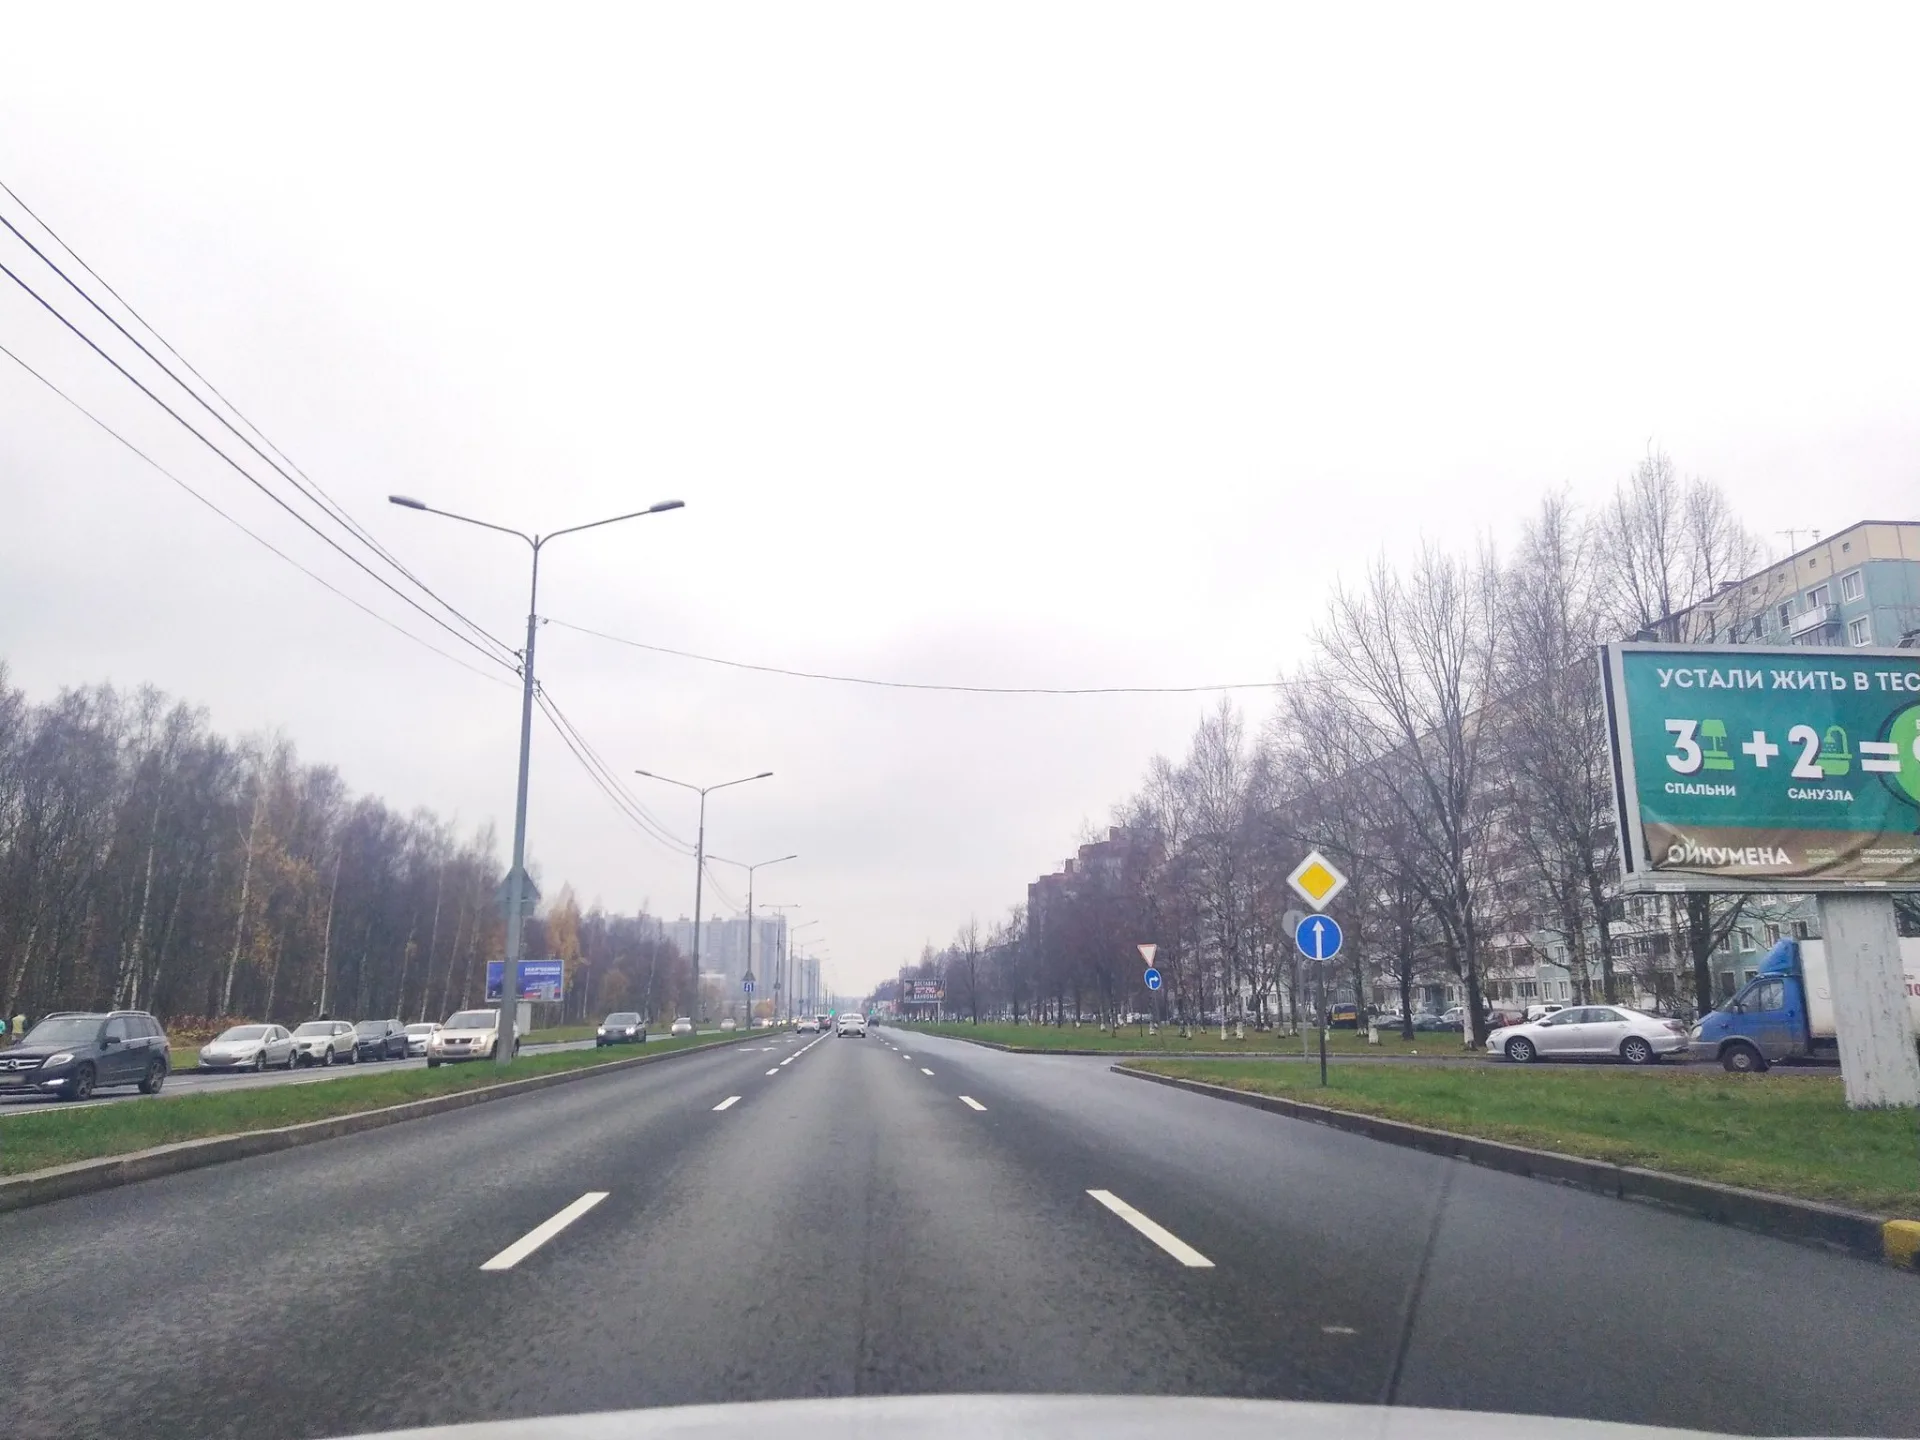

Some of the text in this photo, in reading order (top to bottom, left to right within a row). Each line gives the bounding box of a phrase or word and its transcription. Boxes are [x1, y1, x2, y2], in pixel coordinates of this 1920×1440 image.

[1656, 668, 1764, 689] УСТАЛИ
[1770, 669, 1847, 690] ЖИТЬ
[1853, 671, 1870, 691] В
[1664, 718, 1703, 775] 3
[1787, 724, 1824, 779] 2
[1664, 782, 1737, 797] СПАЛЬНИ
[1787, 786, 1854, 802] САНУЗЛА
[1667, 838, 1793, 866] ОЙКУМЕНА
